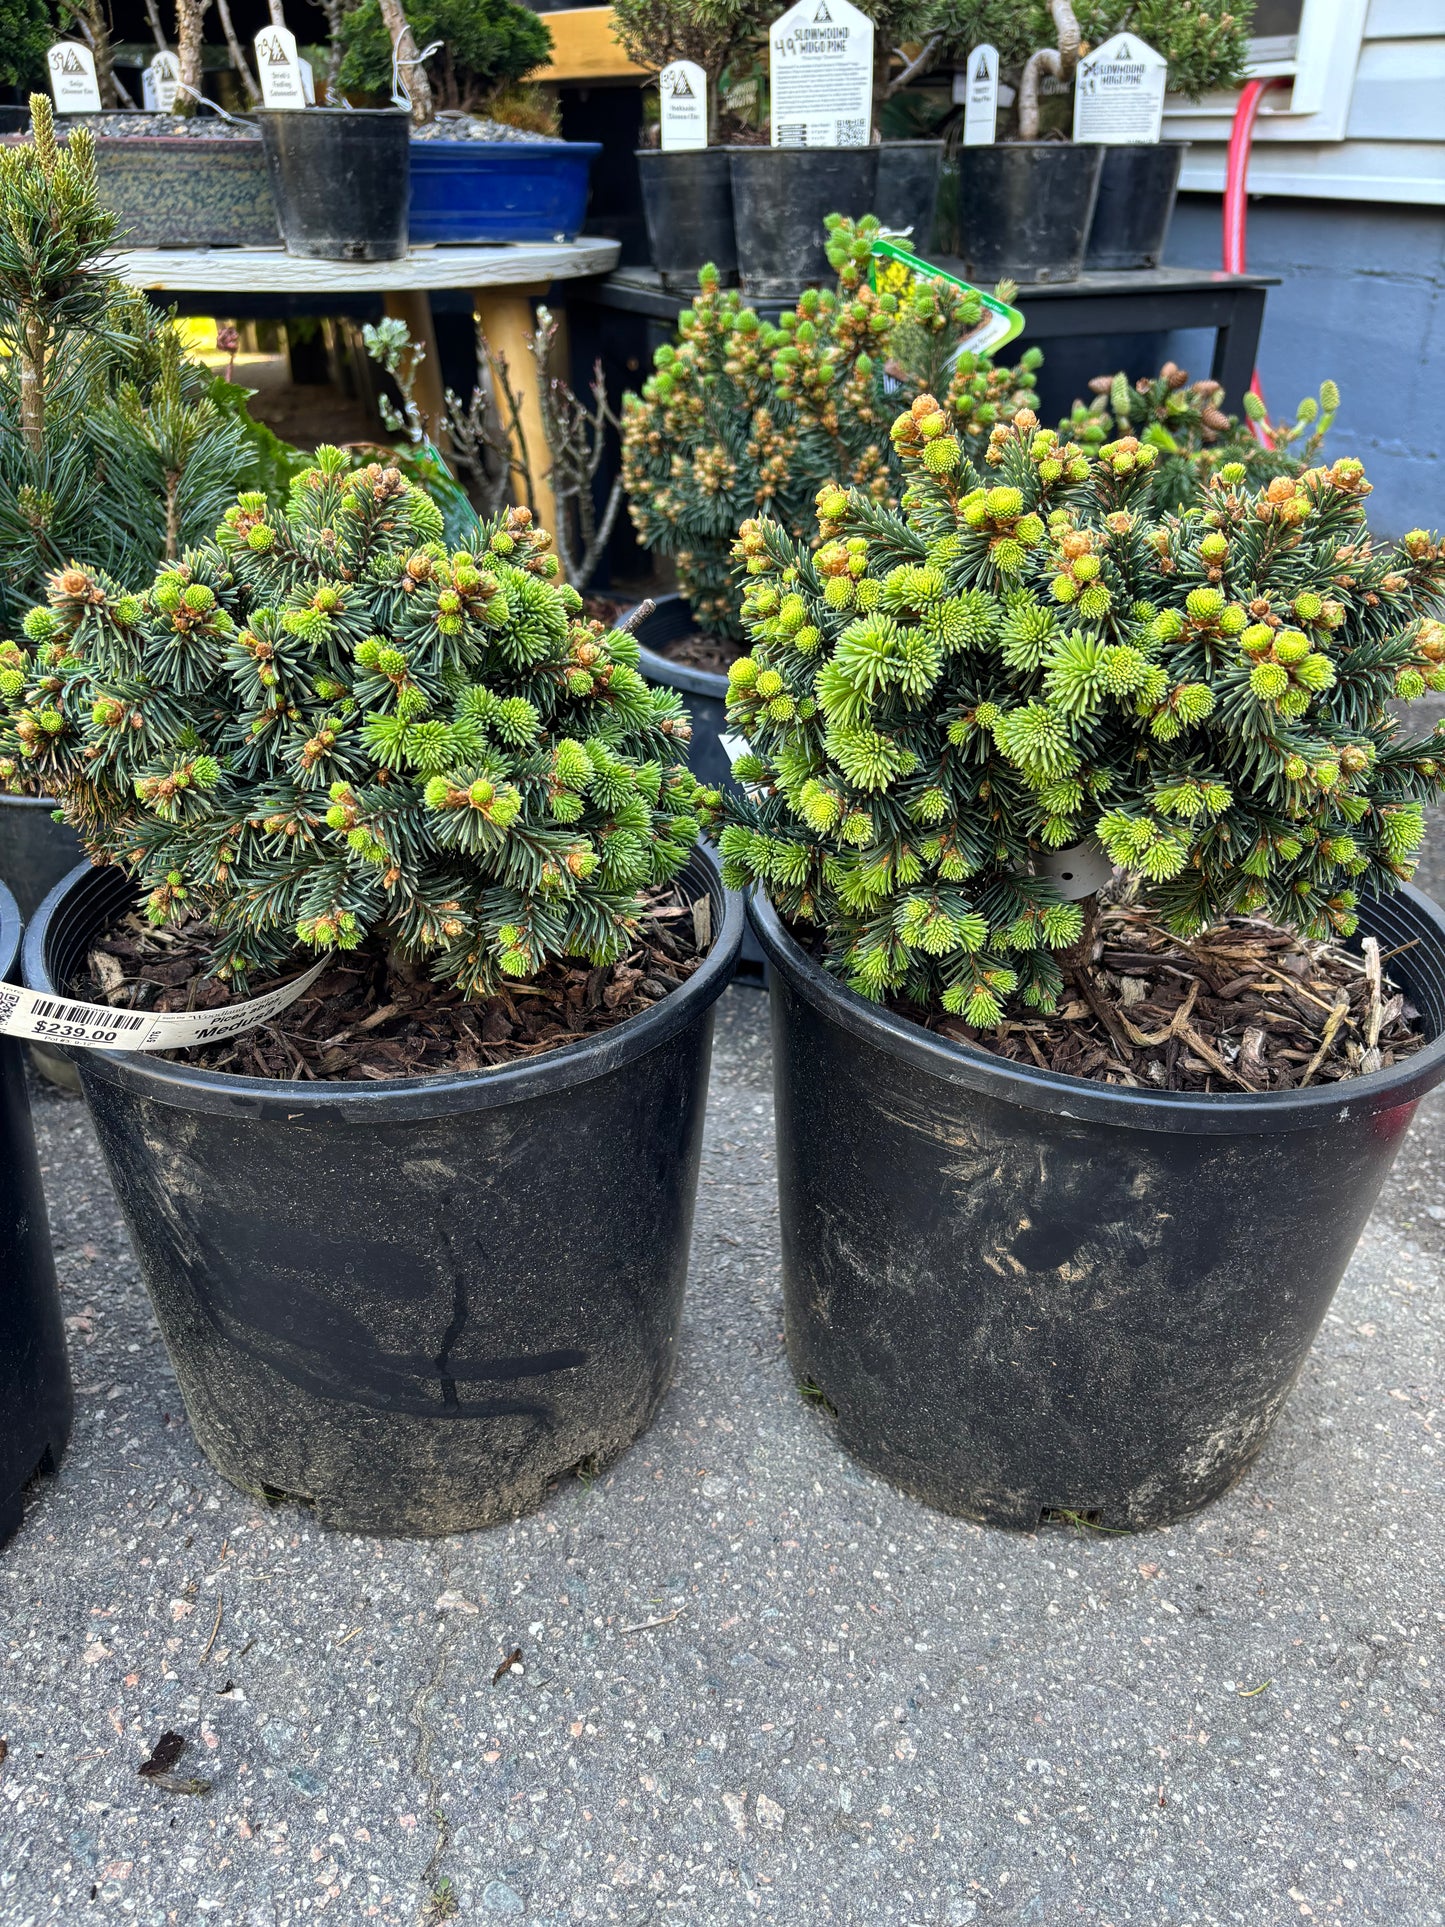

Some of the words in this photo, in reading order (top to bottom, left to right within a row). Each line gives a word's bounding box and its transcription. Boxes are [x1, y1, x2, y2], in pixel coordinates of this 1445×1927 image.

[775, 38, 796, 57] 49
[827, 40, 848, 53] PINE
[210, 1011, 247, 1025] Picea
[250, 997, 281, 1014] abies
[32, 1020, 117, 1041] $239.00
